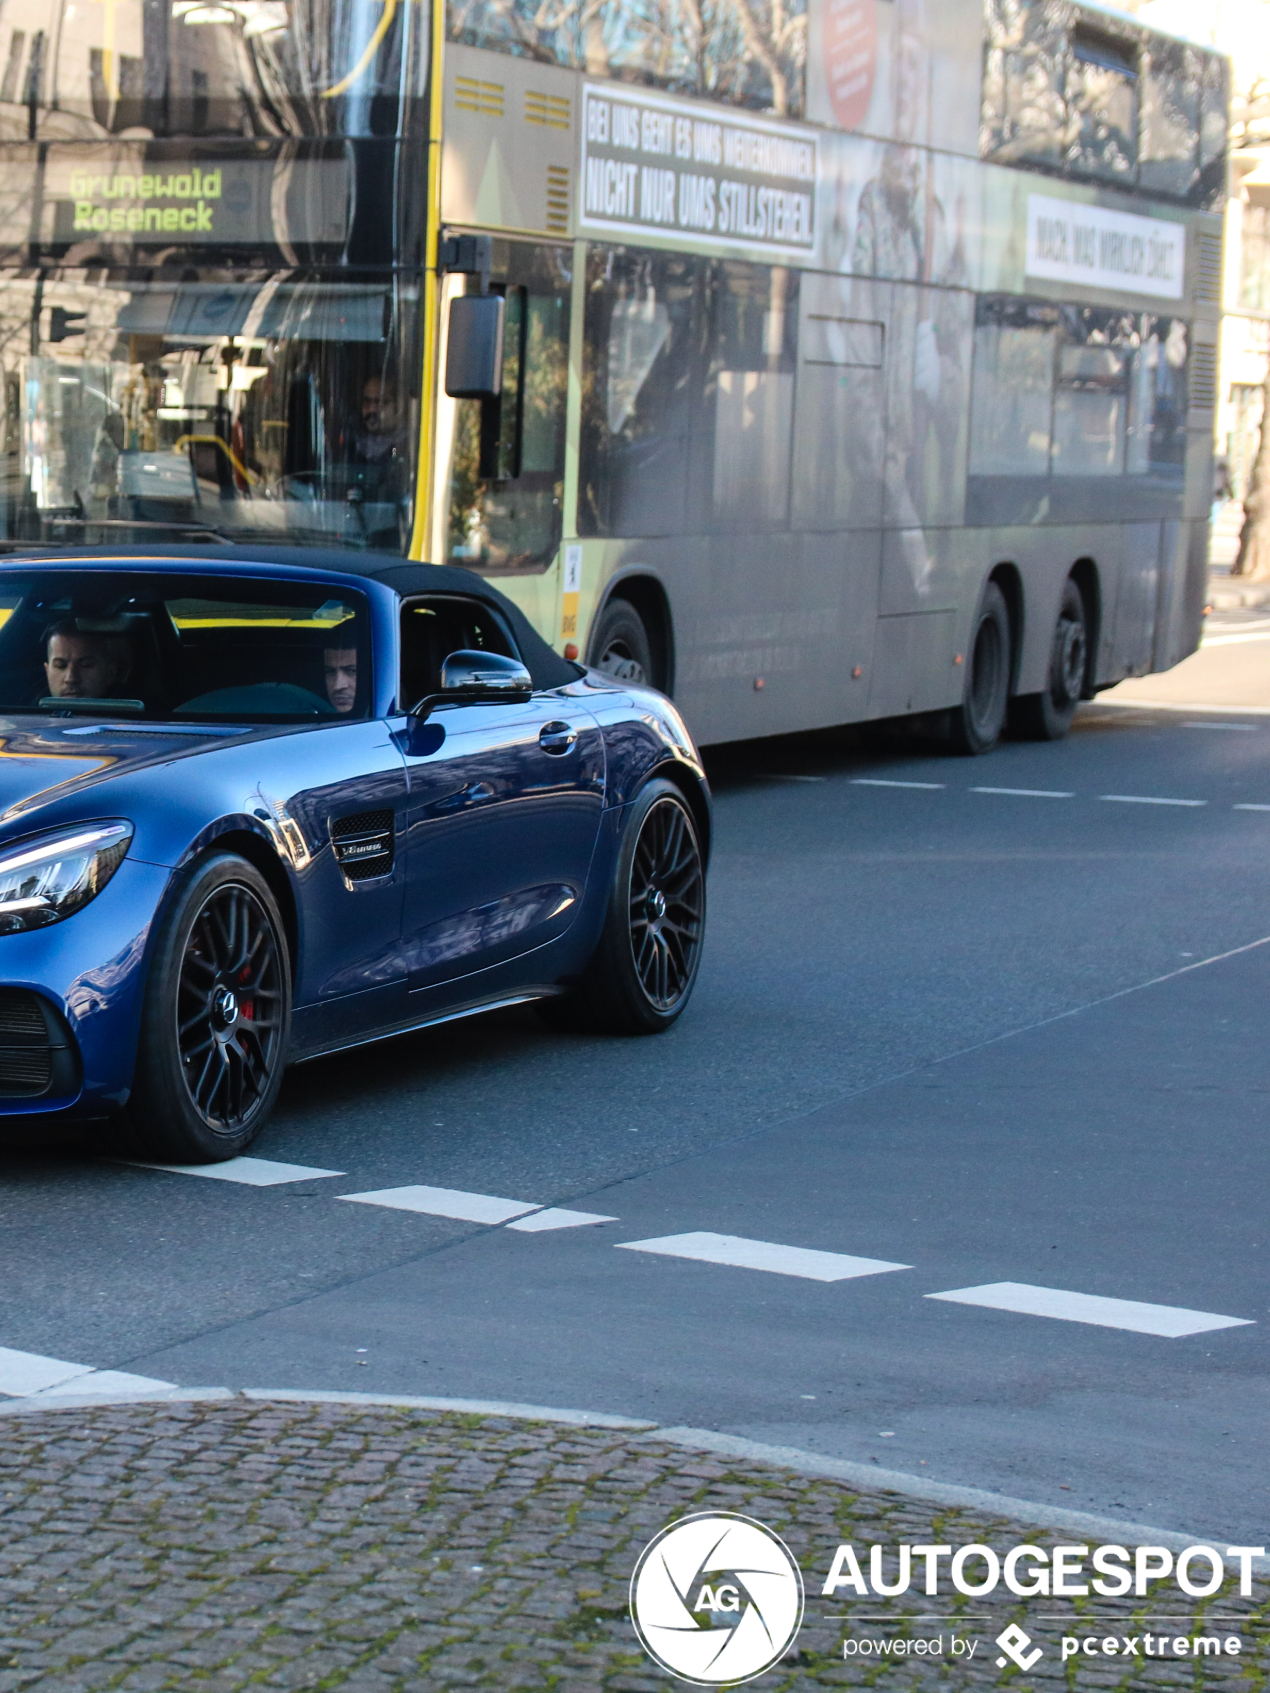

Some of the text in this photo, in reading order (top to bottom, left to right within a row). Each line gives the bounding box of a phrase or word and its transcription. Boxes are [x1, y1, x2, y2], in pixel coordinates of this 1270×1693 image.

[587, 98, 610, 144] BEI
[611, 104, 639, 150] UNS
[641, 109, 673, 155] GEHT
[675, 116, 692, 160] ES
[68, 167, 222, 199] Grunewald
[586, 156, 638, 218] NICHT
[640, 165, 676, 225] NUR
[679, 172, 717, 231] UMS
[74, 200, 214, 232] Roseneck
